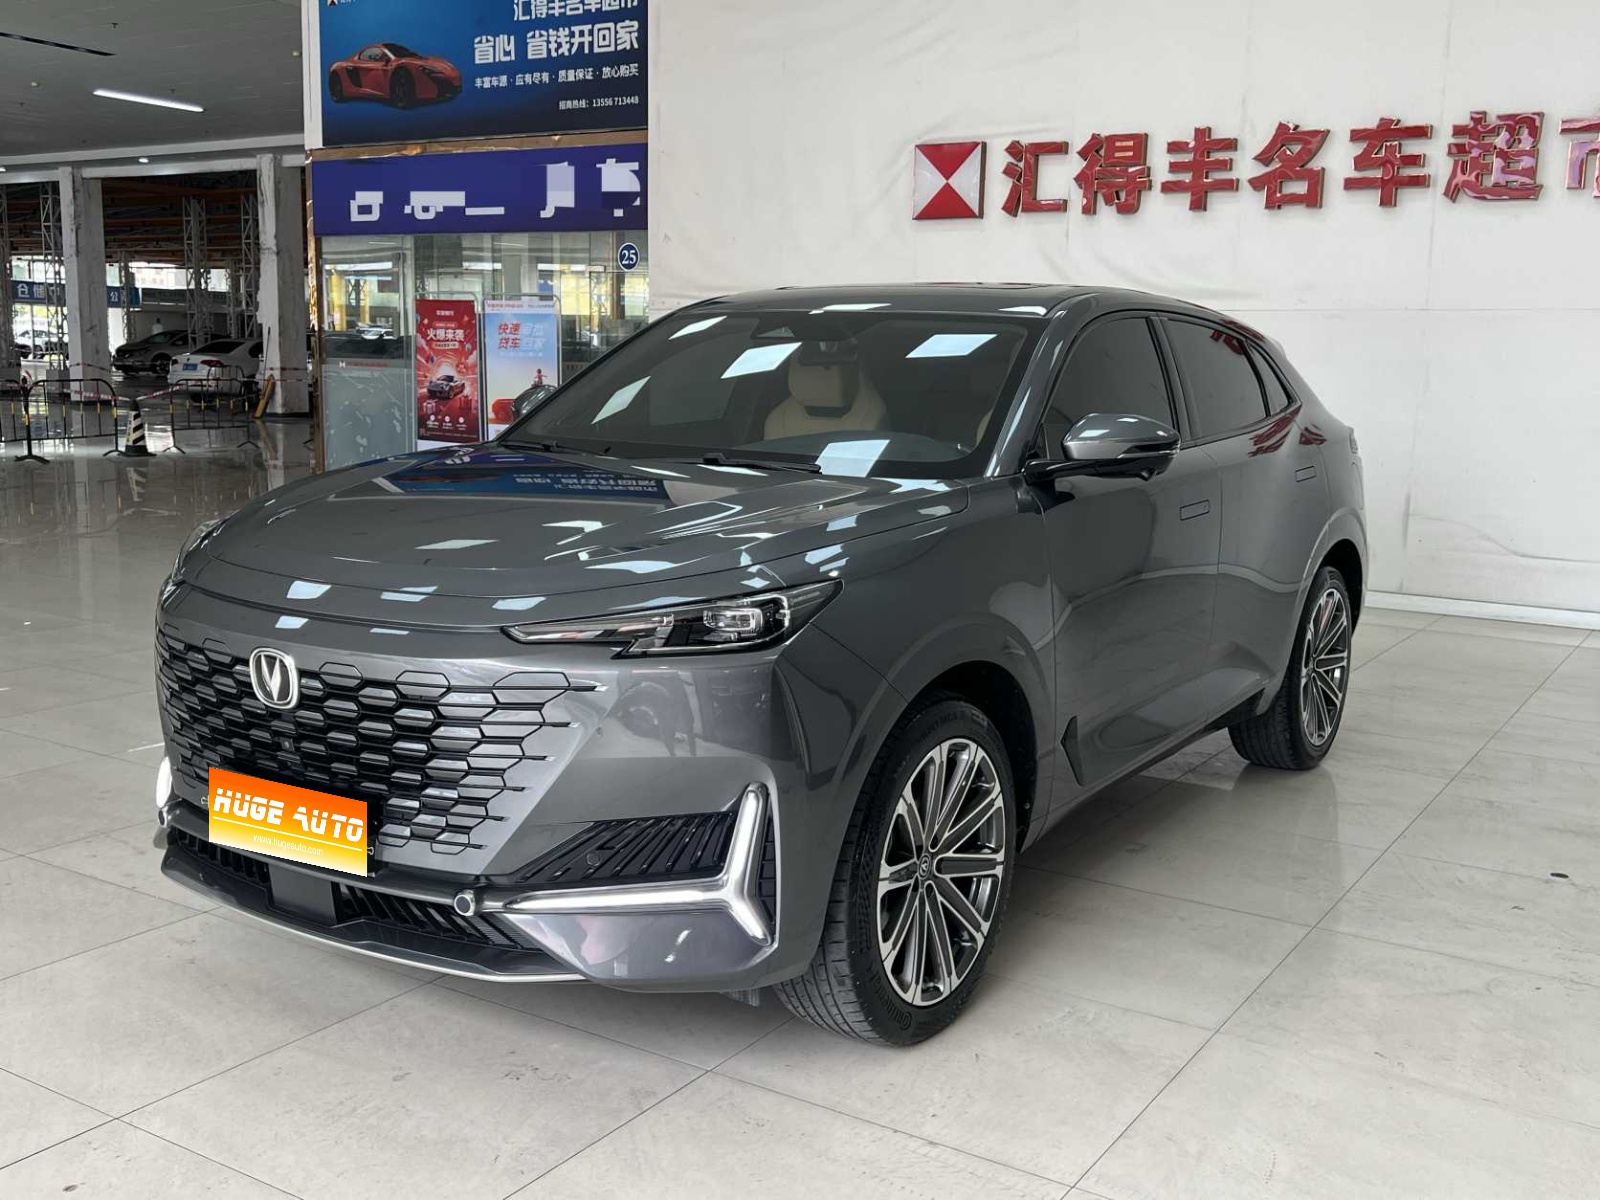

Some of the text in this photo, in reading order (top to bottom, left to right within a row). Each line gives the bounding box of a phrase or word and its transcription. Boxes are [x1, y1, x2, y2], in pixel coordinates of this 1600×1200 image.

[474, 19, 639, 64] 省心 省钱开回家
[602, 63, 639, 79] 放心购买
[621, 249, 636, 265] 25
